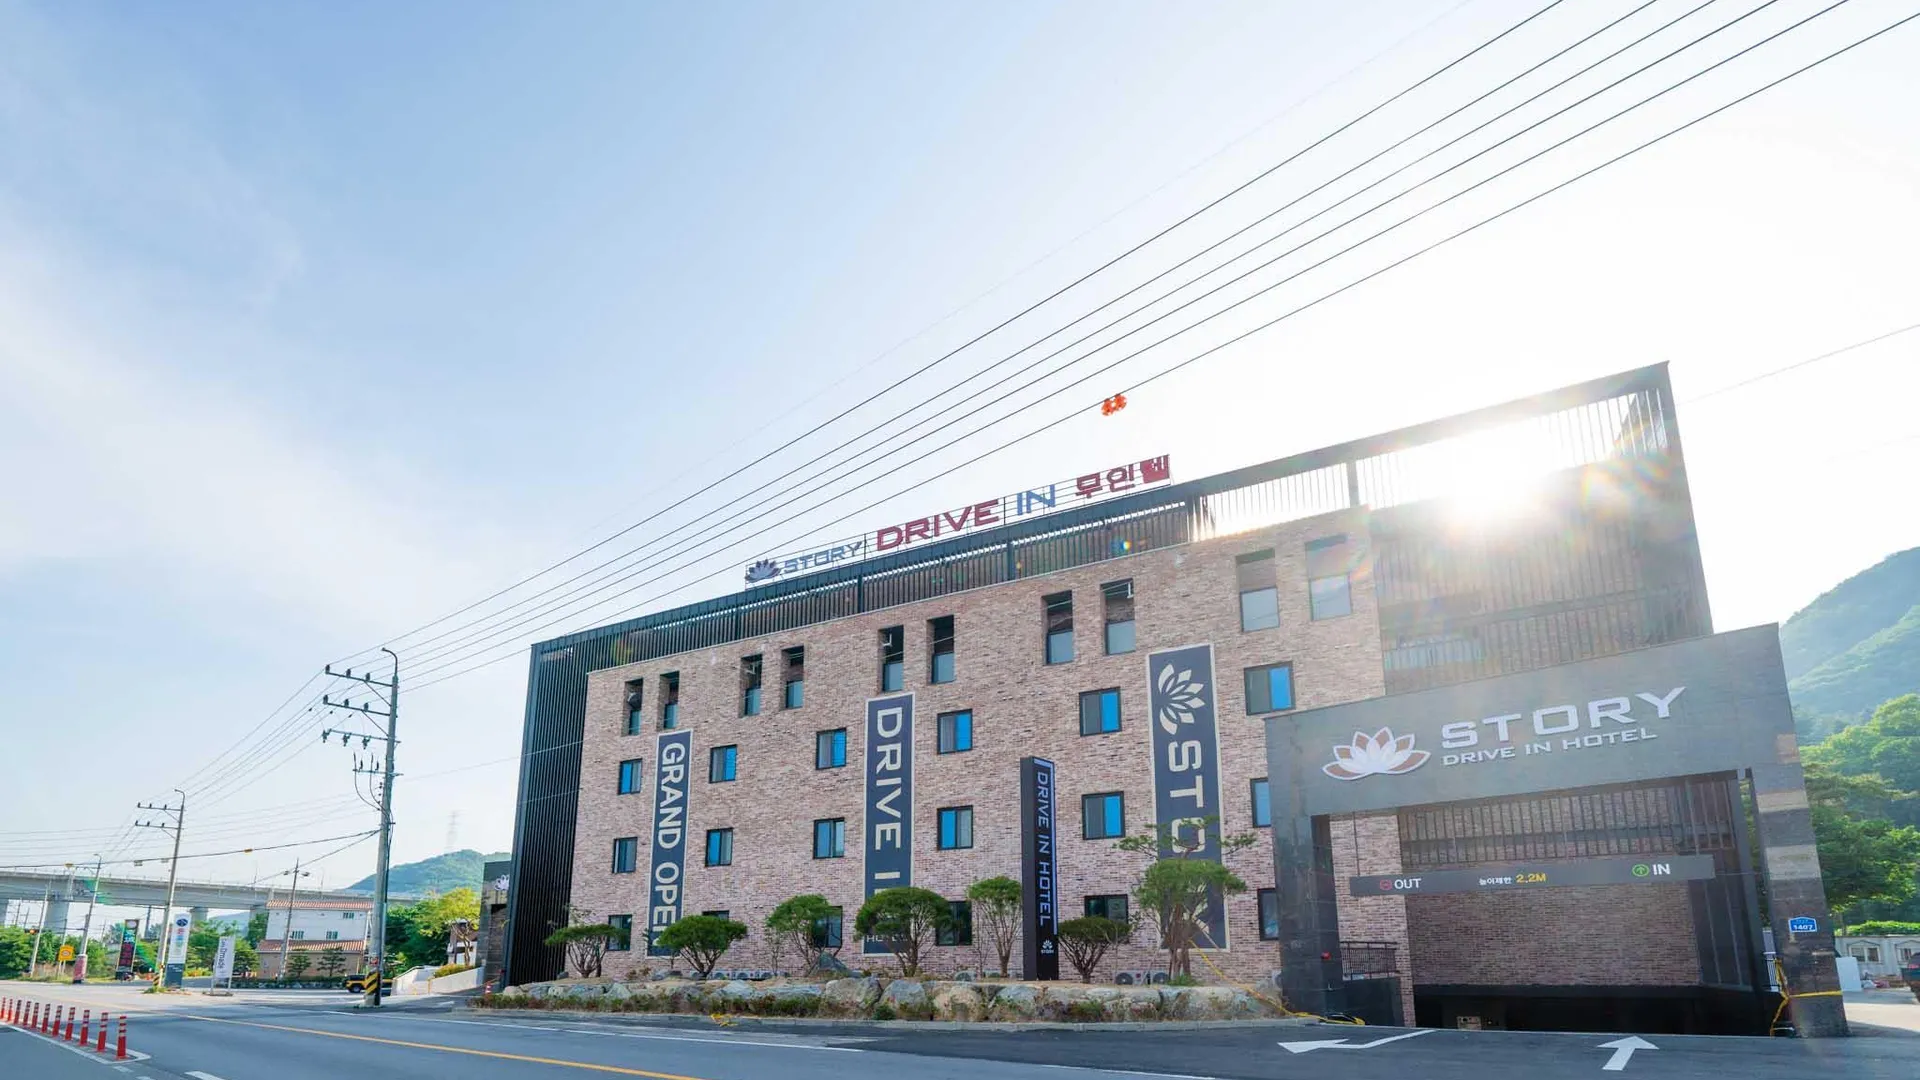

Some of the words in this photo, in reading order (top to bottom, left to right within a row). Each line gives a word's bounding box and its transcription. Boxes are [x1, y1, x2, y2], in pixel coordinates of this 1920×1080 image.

[784, 541, 862, 574] STORY
[876, 499, 1000, 551] DRIVE
[1016, 484, 1056, 516] IN
[1441, 686, 1687, 749] STORY
[1442, 747, 1516, 766] DRIVE
[1525, 743, 1552, 755] IN
[1562, 727, 1658, 751] HOTEL
[657, 742, 686, 849] GRAND
[875, 706, 903, 850] DRIVE
[1037, 772, 1049, 828] DRIVE
[1038, 834, 1050, 855] IN
[1652, 863, 1671, 876] IN
[652, 861, 680, 946] OPE
[1037, 862, 1051, 927] HOTEL
[1394, 877, 1422, 890] OUT
[1515, 873, 1546, 884] 2.2M
